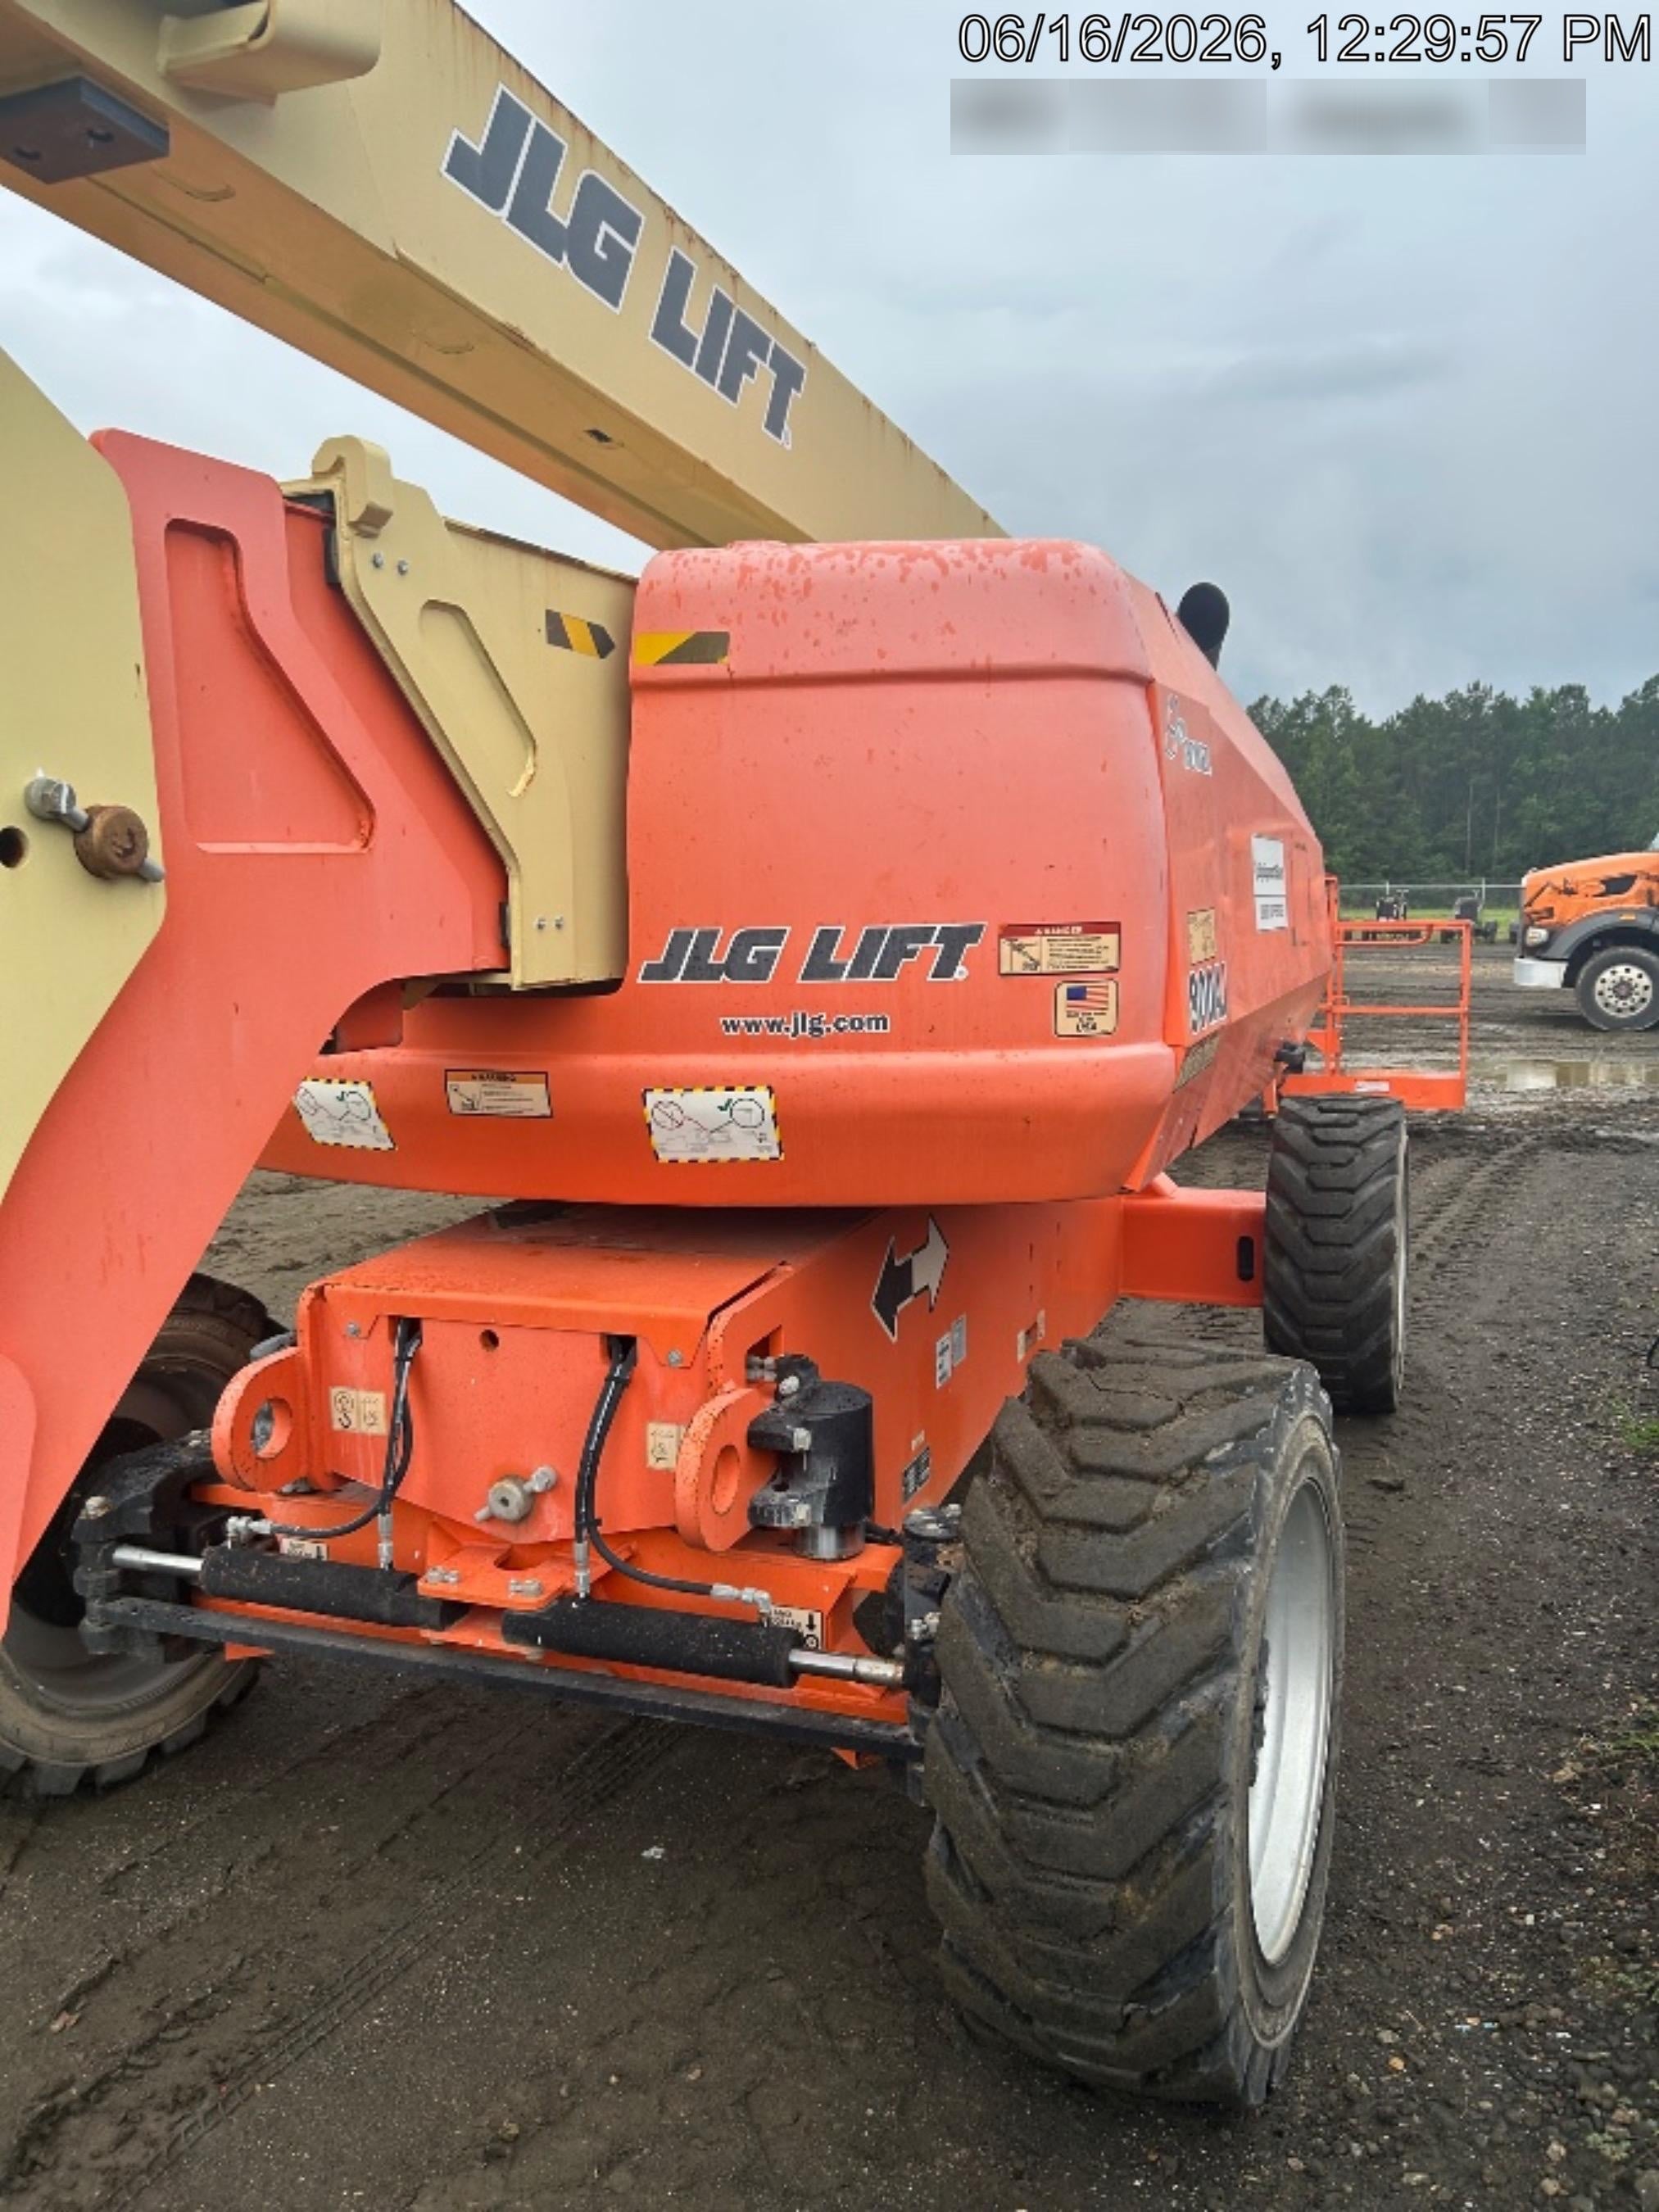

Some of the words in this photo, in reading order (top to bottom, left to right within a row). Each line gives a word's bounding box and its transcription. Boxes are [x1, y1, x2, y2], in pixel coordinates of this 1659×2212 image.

[441, 81, 645, 315] JLG
[648, 245, 806, 447] LIFT
[637, 925, 791, 982] JLG
[796, 921, 987, 982] LIFT
[719, 1010, 891, 1040] www.jlg.com
